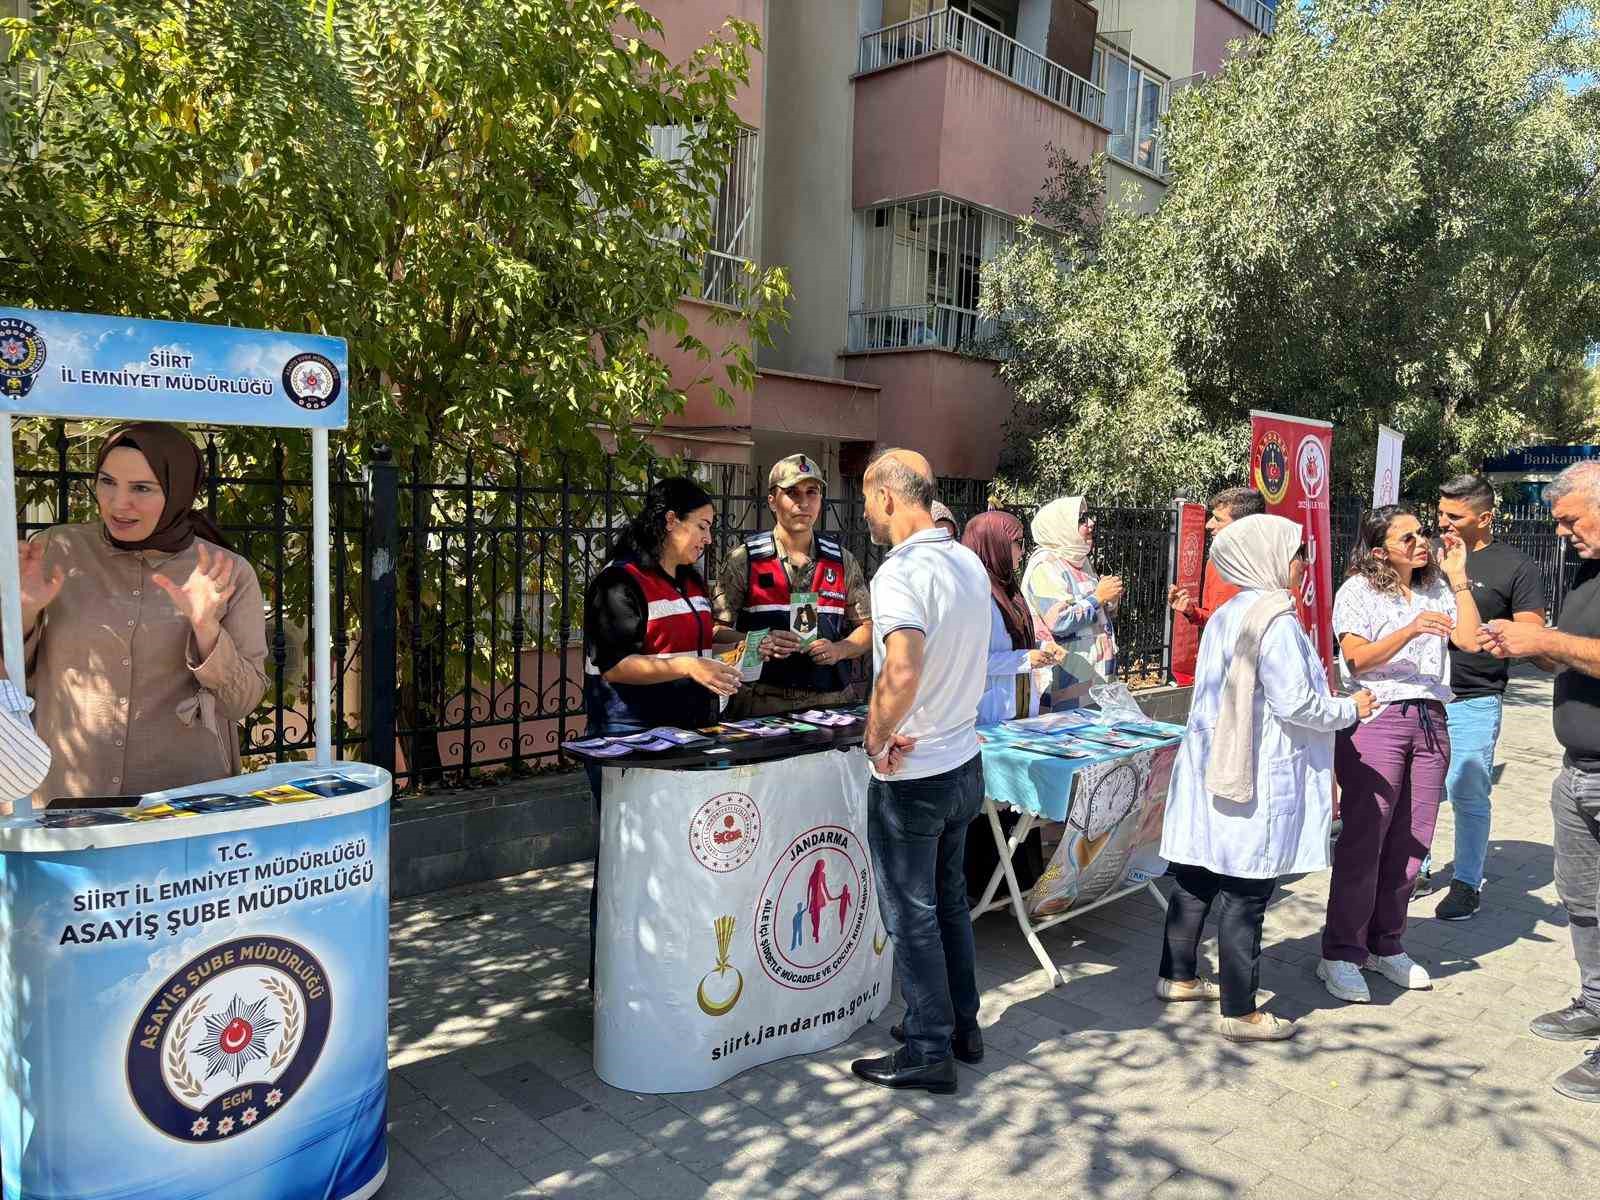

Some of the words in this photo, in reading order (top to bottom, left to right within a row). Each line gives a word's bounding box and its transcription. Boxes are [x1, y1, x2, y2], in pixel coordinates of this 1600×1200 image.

[150, 351, 192, 369] SİİRT
[61, 369, 77, 383] İL
[81, 368, 162, 389] EMNİYET
[165, 374, 273, 396] MÜDÜRLÜĞÜ
[217, 842, 253, 862] T.C.
[790, 831, 849, 862] JANDARMA
[73, 890, 130, 912] SİİRT
[136, 884, 154, 905] İL
[159, 868, 250, 901] EMNİYET
[254, 840, 366, 882] MÜDÜRLÜĞÜ
[59, 911, 158, 945] ASAYİŞ
[166, 899, 231, 935] ŞUBE
[238, 863, 374, 914] MÜDÜRLÜĞÜ
[761, 899, 773, 922] AİLE
[852, 912, 864, 941] KISIM
[759, 938, 783, 975] ŞİDDETLE
[832, 941, 853, 969] ÇOCUK
[780, 969, 821, 984] MÜCADELE
[821, 965, 832, 977] VE
[140, 983, 188, 1050] ASAYİŞ
[187, 950, 235, 986] ŞUBE
[240, 942, 324, 1001] MÜDÜRLÜĞÜ
[711, 981, 881, 1061] siirt.jandarma.gov.tr
[222, 1088, 253, 1111] EGM
